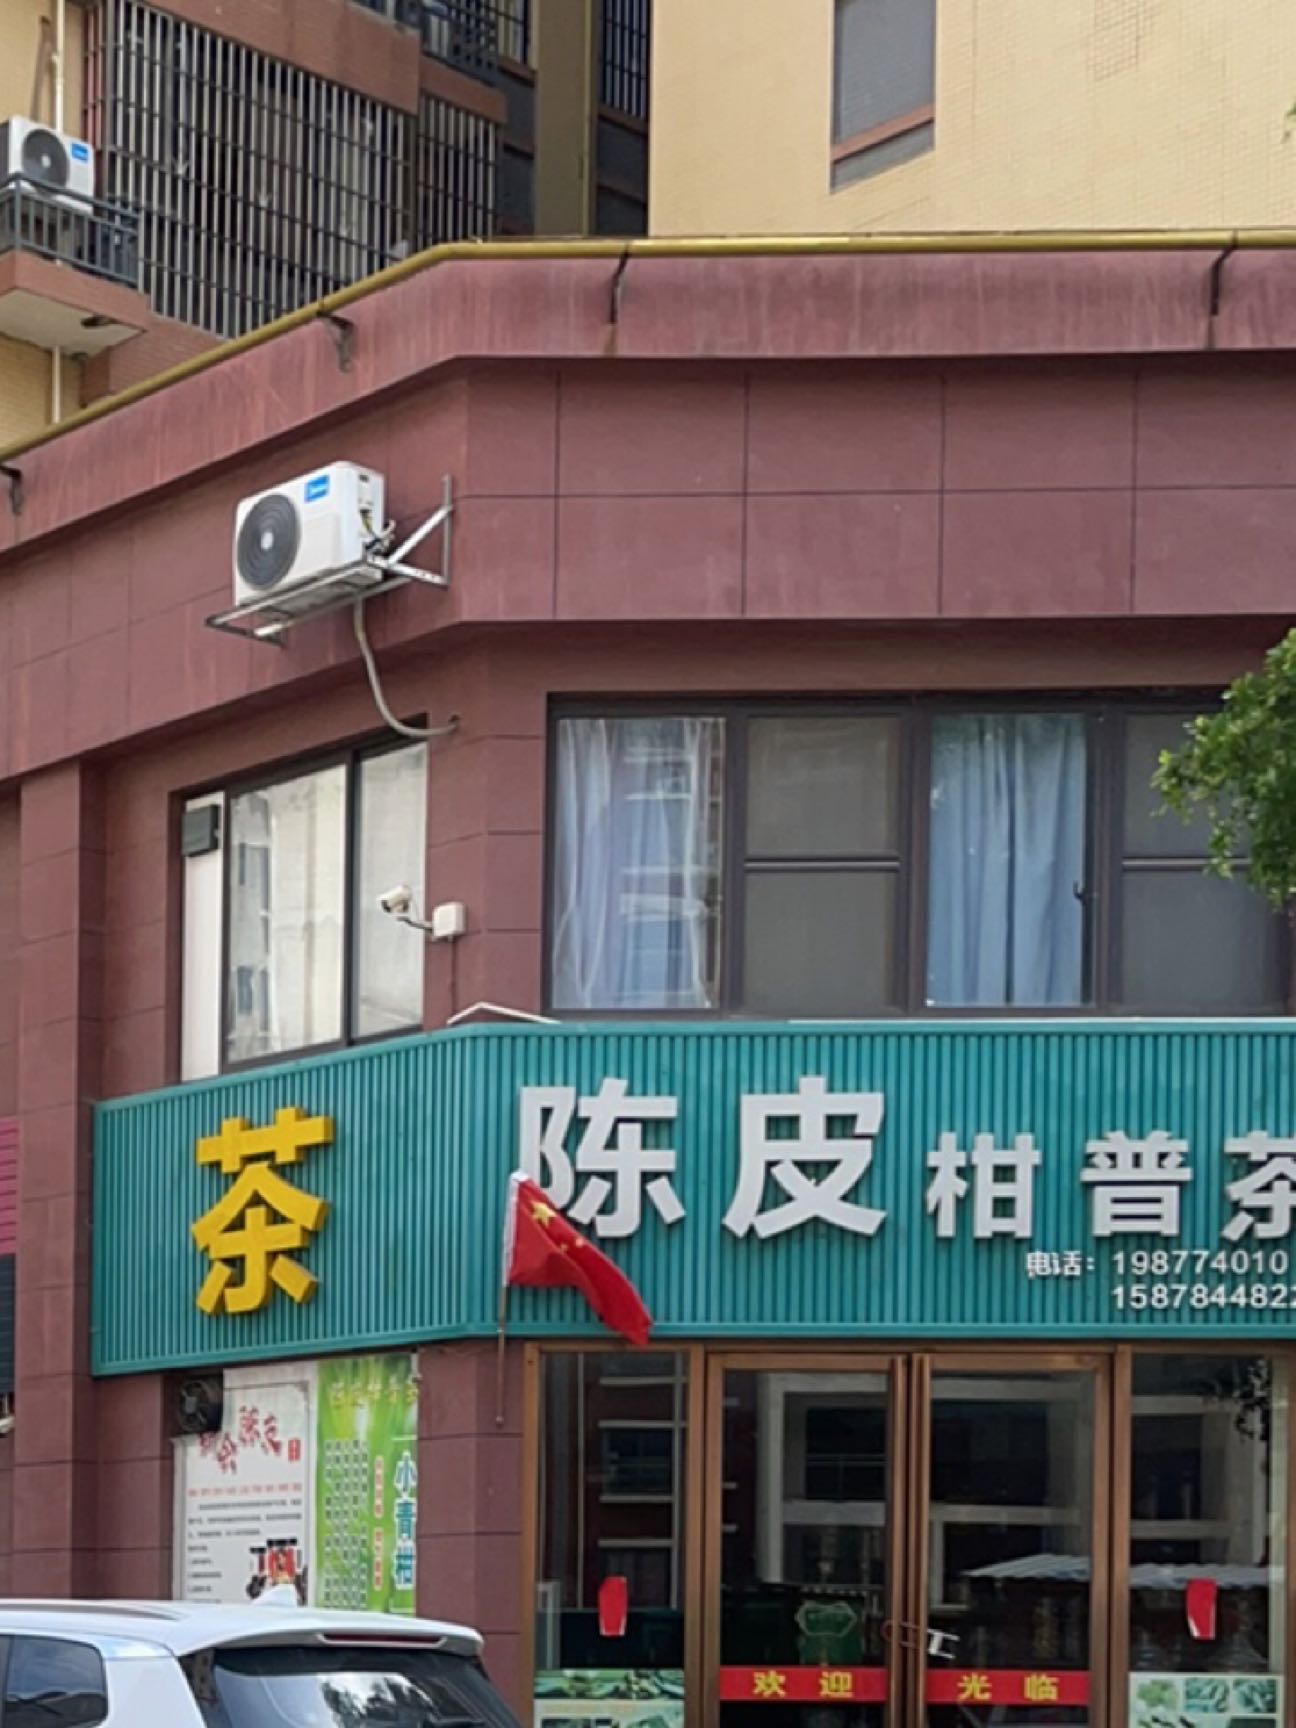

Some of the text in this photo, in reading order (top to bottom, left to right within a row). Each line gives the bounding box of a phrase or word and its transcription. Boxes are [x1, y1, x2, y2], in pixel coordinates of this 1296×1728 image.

[191, 1105, 334, 1313] 茶
[1111, 1283, 1296, 1310] 158784482
[754, 1669, 853, 1698] 欢迎
[957, 1673, 1059, 1701] 光临
